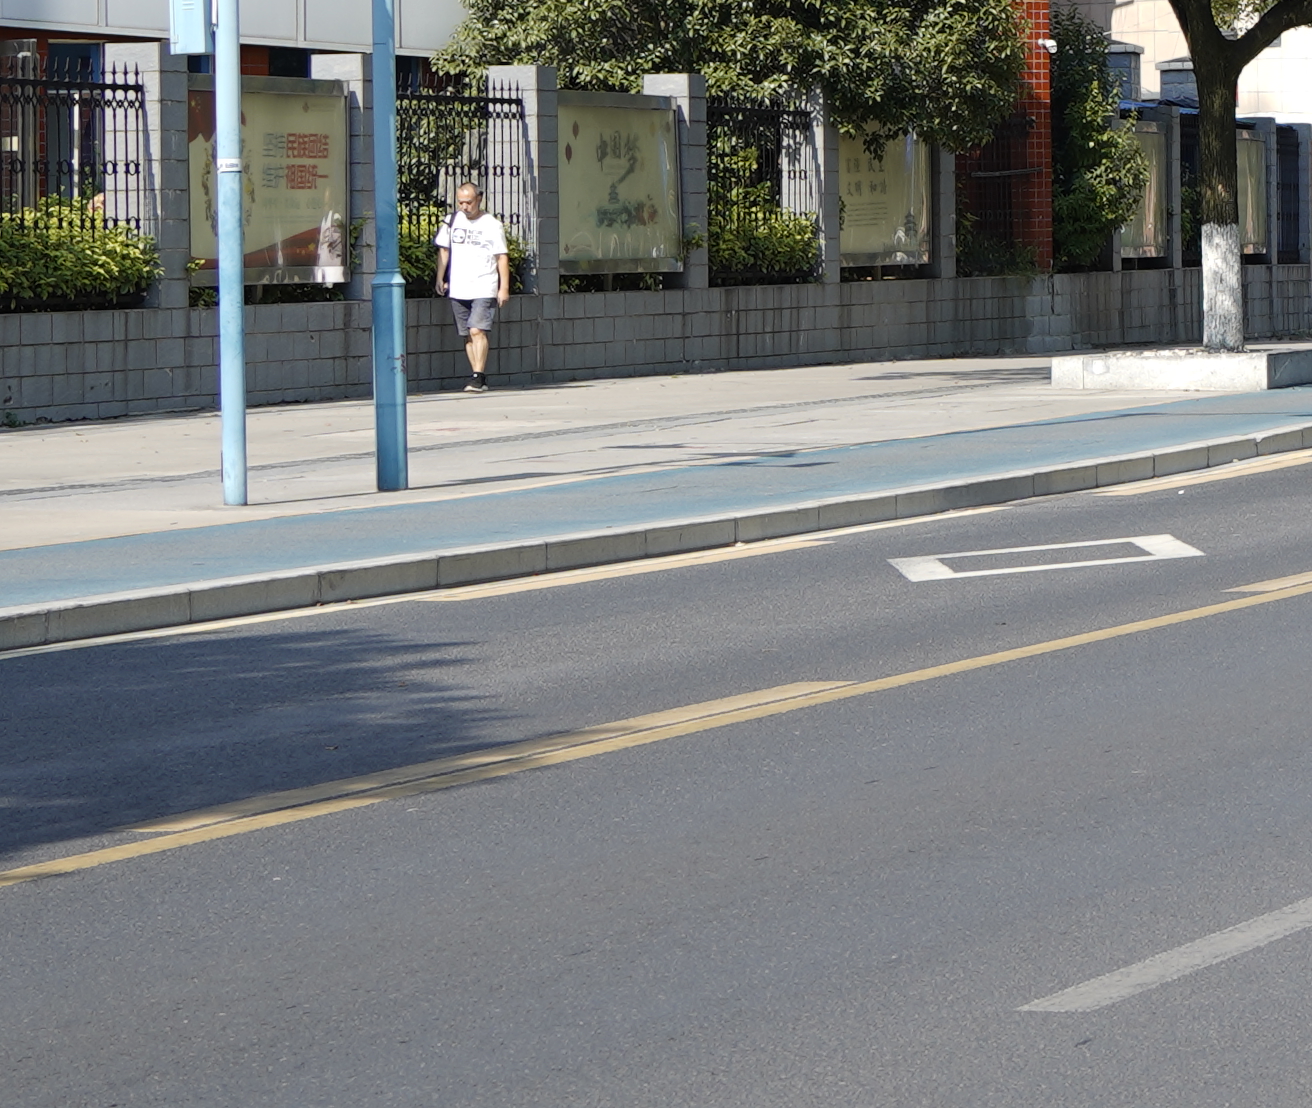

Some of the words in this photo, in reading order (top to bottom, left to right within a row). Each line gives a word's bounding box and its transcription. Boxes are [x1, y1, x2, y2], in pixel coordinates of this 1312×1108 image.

[262, 131, 330, 159] 坚持民族团结
[261, 163, 329, 190] 维护祖国统一
